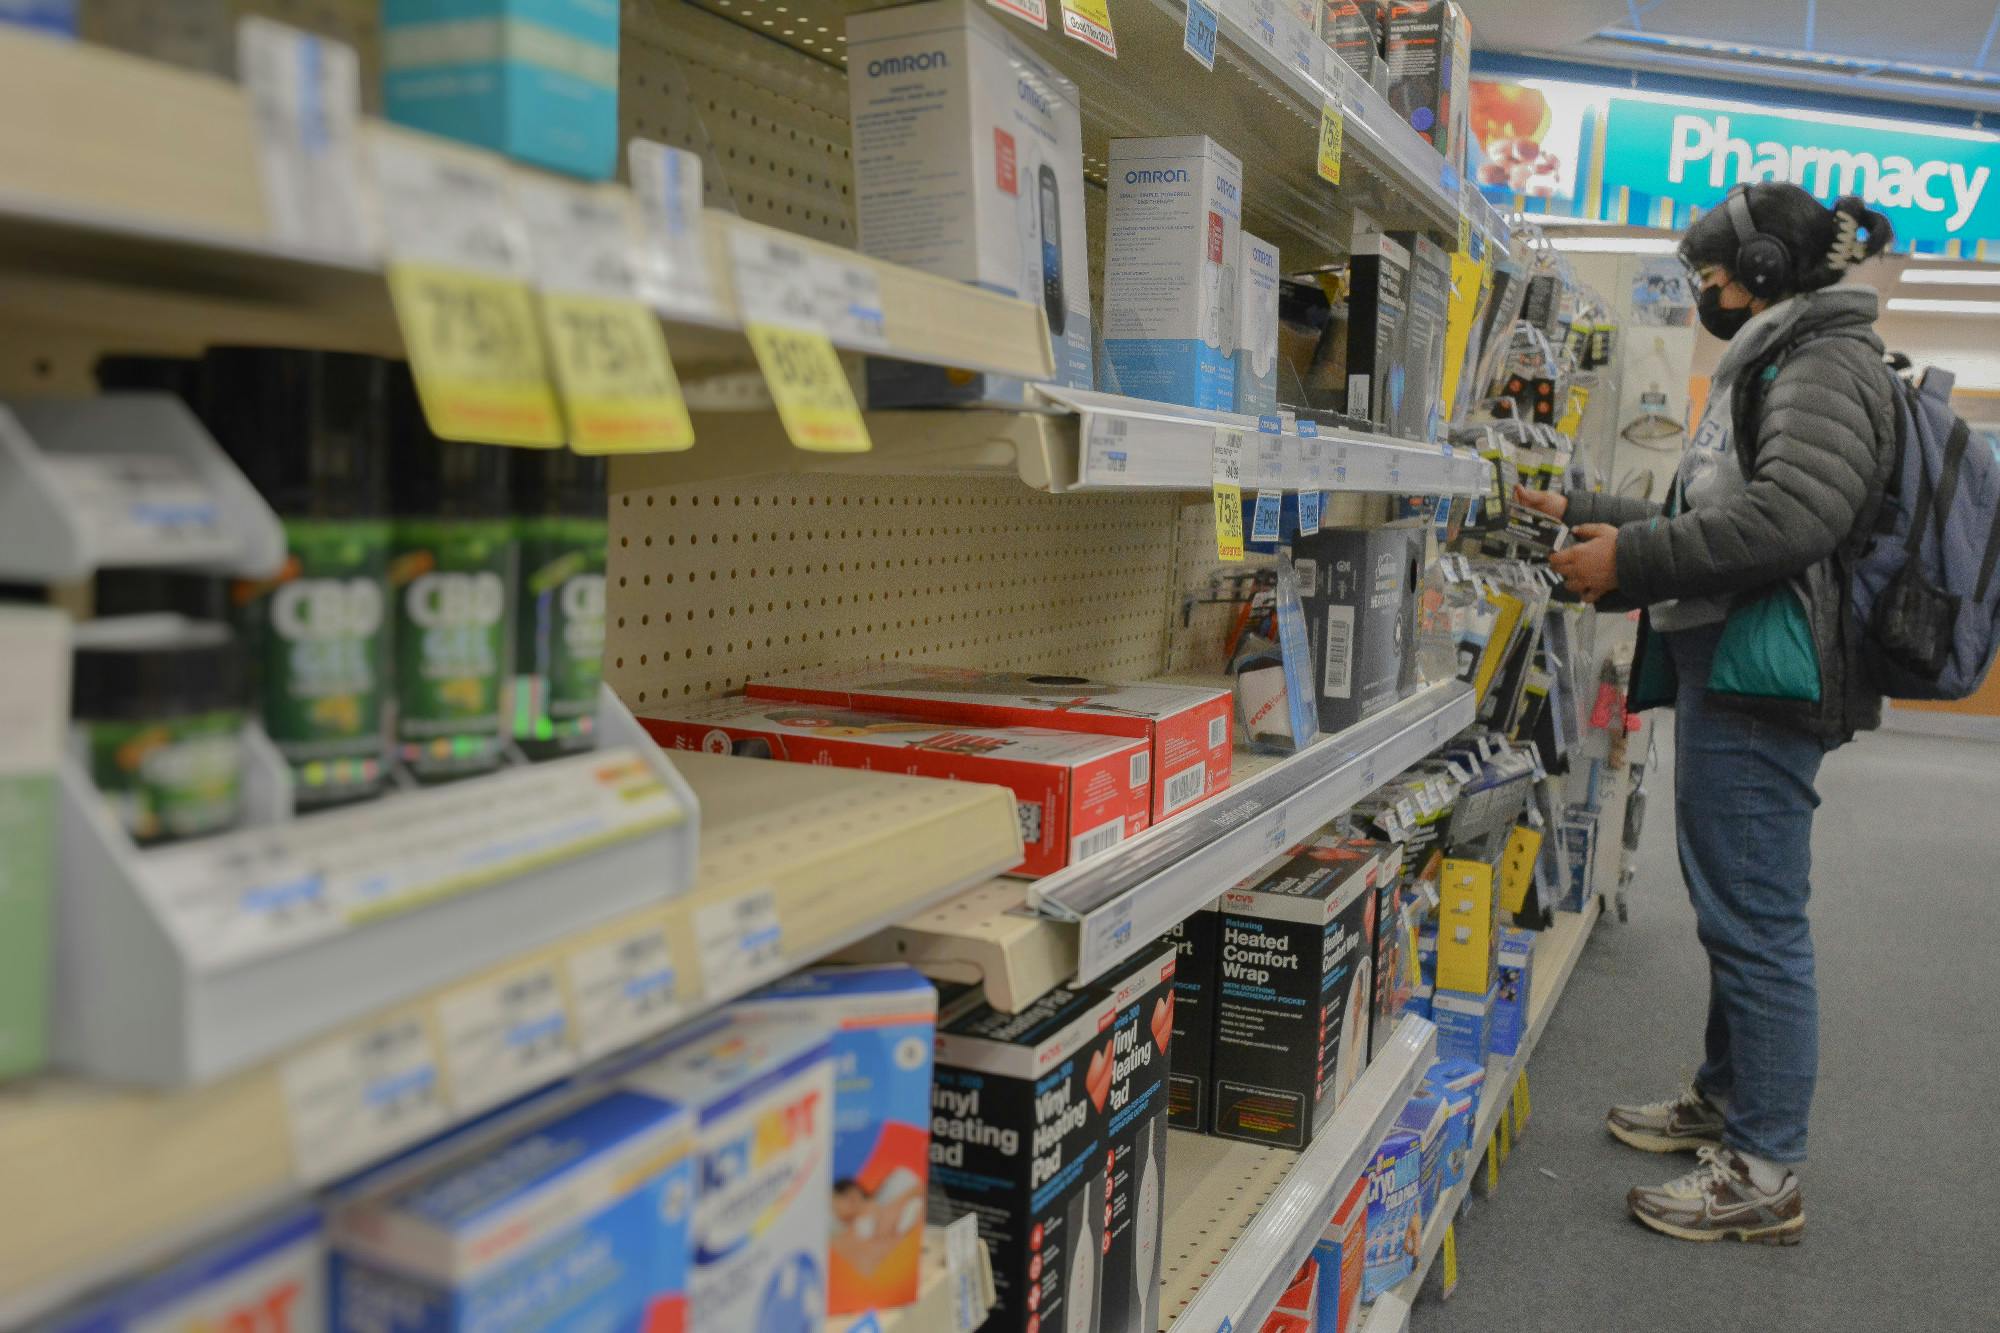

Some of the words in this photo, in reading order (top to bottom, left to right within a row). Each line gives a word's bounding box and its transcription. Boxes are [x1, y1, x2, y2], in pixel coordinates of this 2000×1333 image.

[868, 51, 948, 78] OMRON
[1125, 169, 1188, 184] OMRON
[1667, 114, 1990, 232] Pharmacy
[1224, 927, 1289, 951] Heated
[1223, 945, 1298, 970] Comfort
[1222, 961, 1270, 985] Wrap
[932, 1083, 980, 1118] inyl
[931, 1115, 1020, 1157] eating
[930, 1141, 964, 1168] ad
